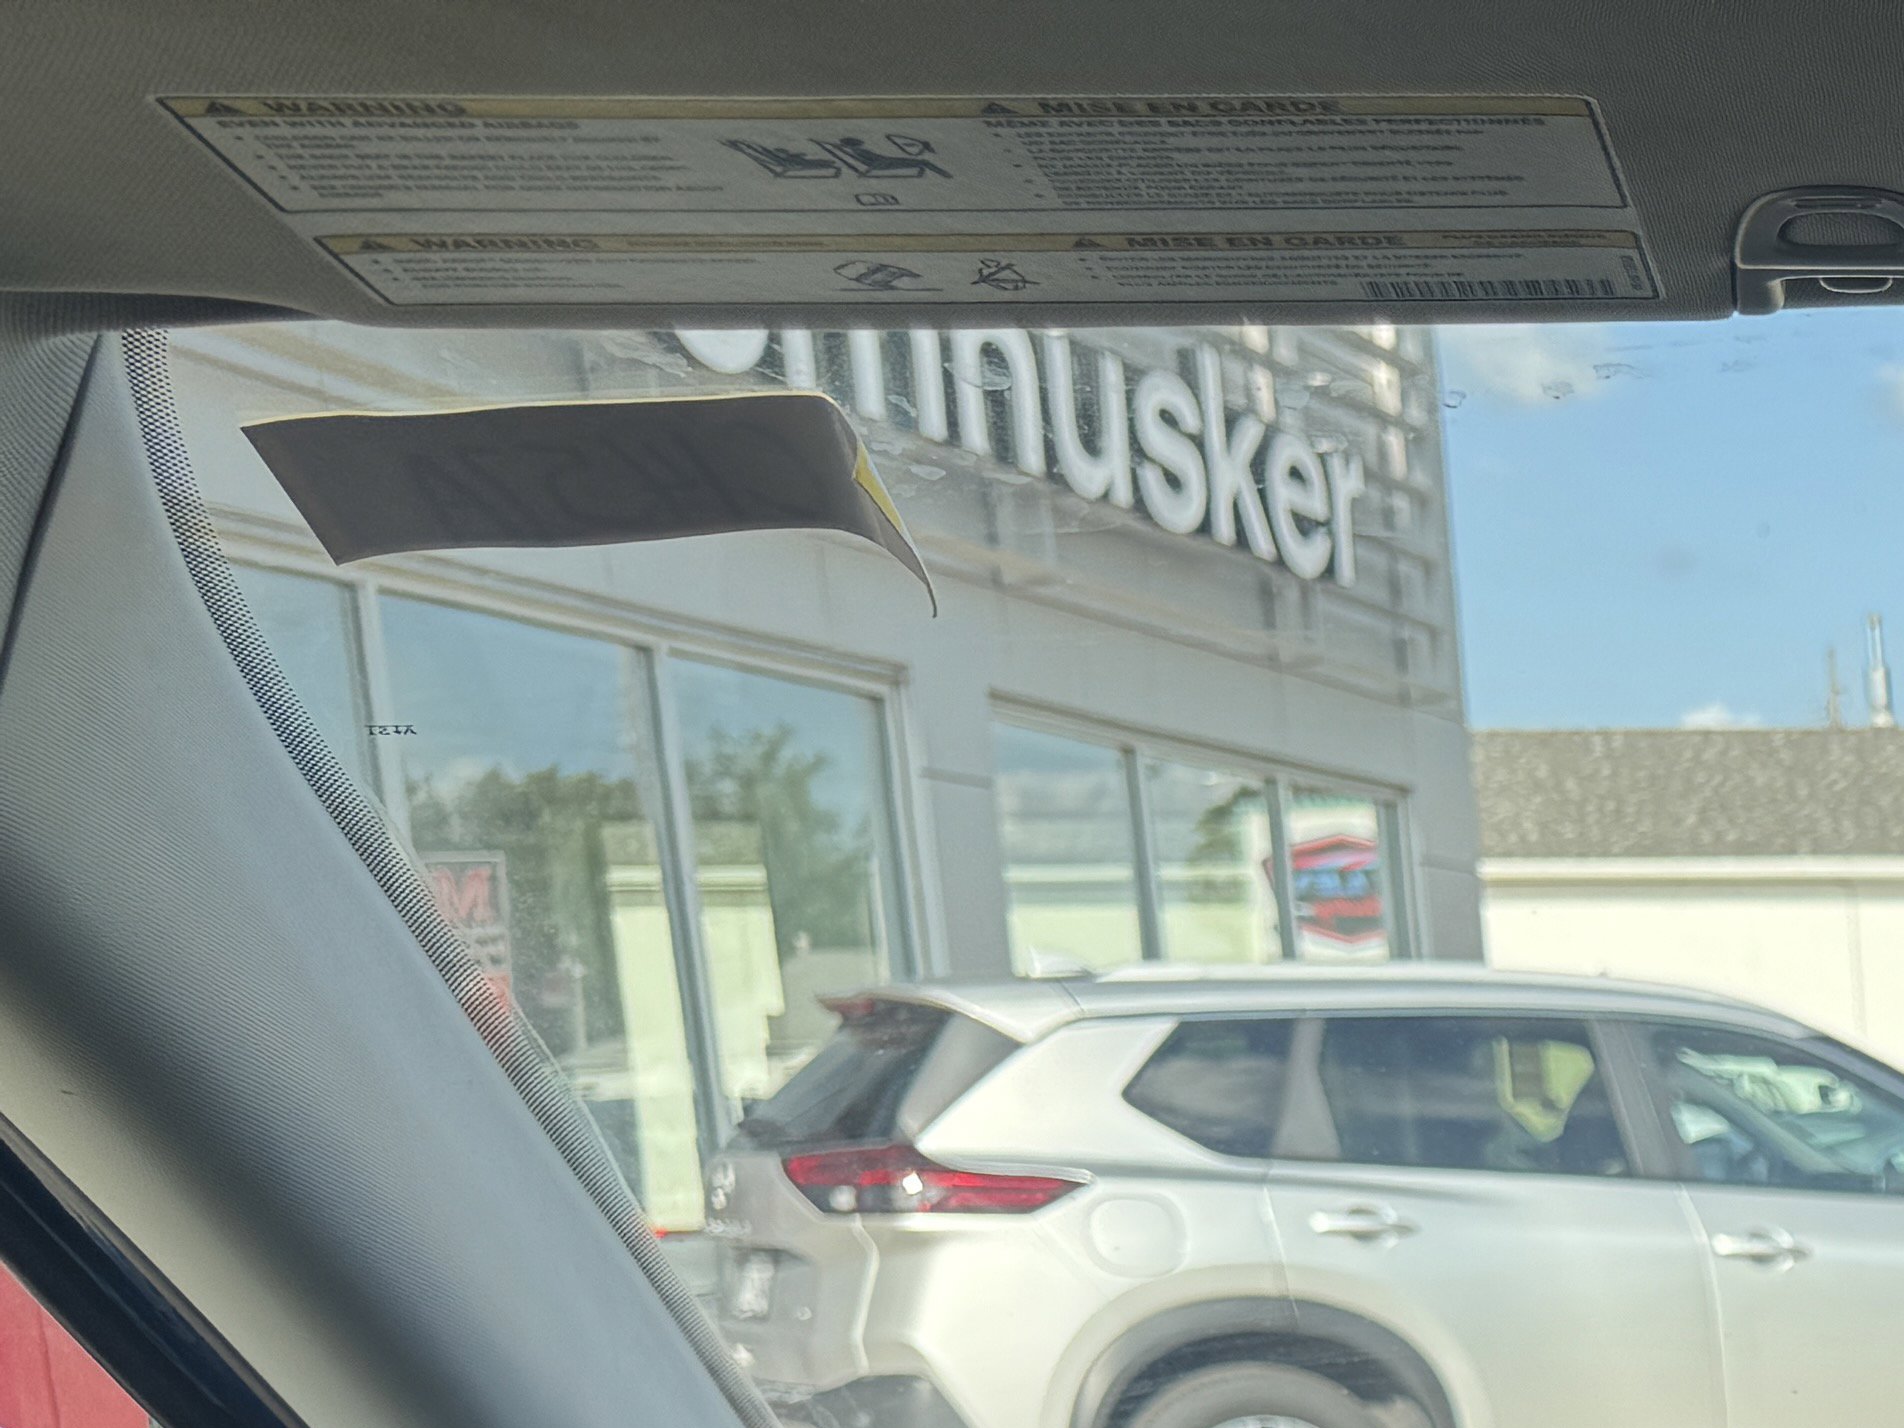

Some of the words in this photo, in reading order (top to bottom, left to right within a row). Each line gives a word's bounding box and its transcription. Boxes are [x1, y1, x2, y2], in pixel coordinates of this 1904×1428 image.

[262, 101, 467, 117] WARNING
[1037, 101, 1137, 115] MISE
[1149, 101, 1199, 115] EN
[1210, 100, 1341, 115] GARDE
[410, 237, 600, 251] WARNING
[1126, 236, 1222, 249] MISE
[1230, 236, 1275, 249] EN
[1283, 235, 1406, 248] GARDE
